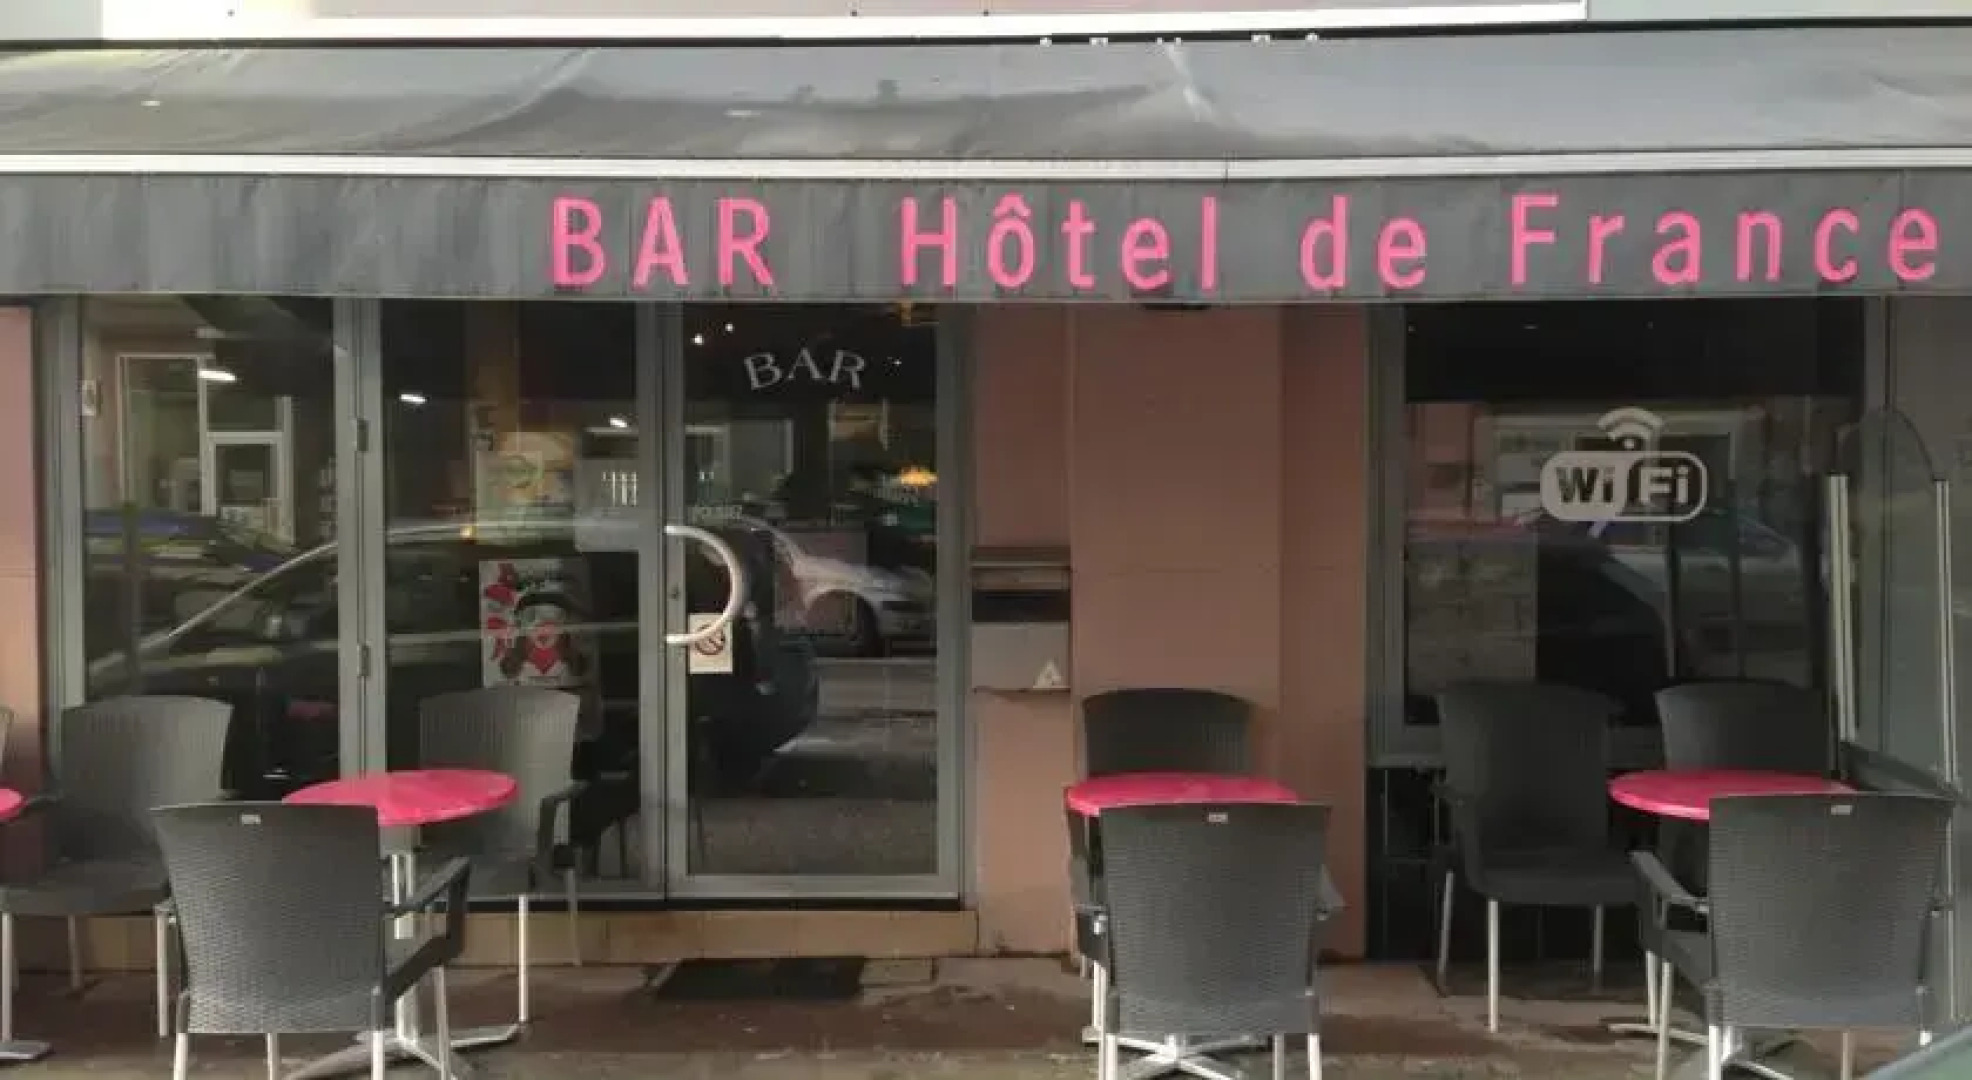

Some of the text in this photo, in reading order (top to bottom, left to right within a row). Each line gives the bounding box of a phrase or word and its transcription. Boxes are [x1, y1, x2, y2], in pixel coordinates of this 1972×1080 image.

[548, 192, 1940, 292] BAR Hôtel de France
[744, 347, 865, 391] BAR
